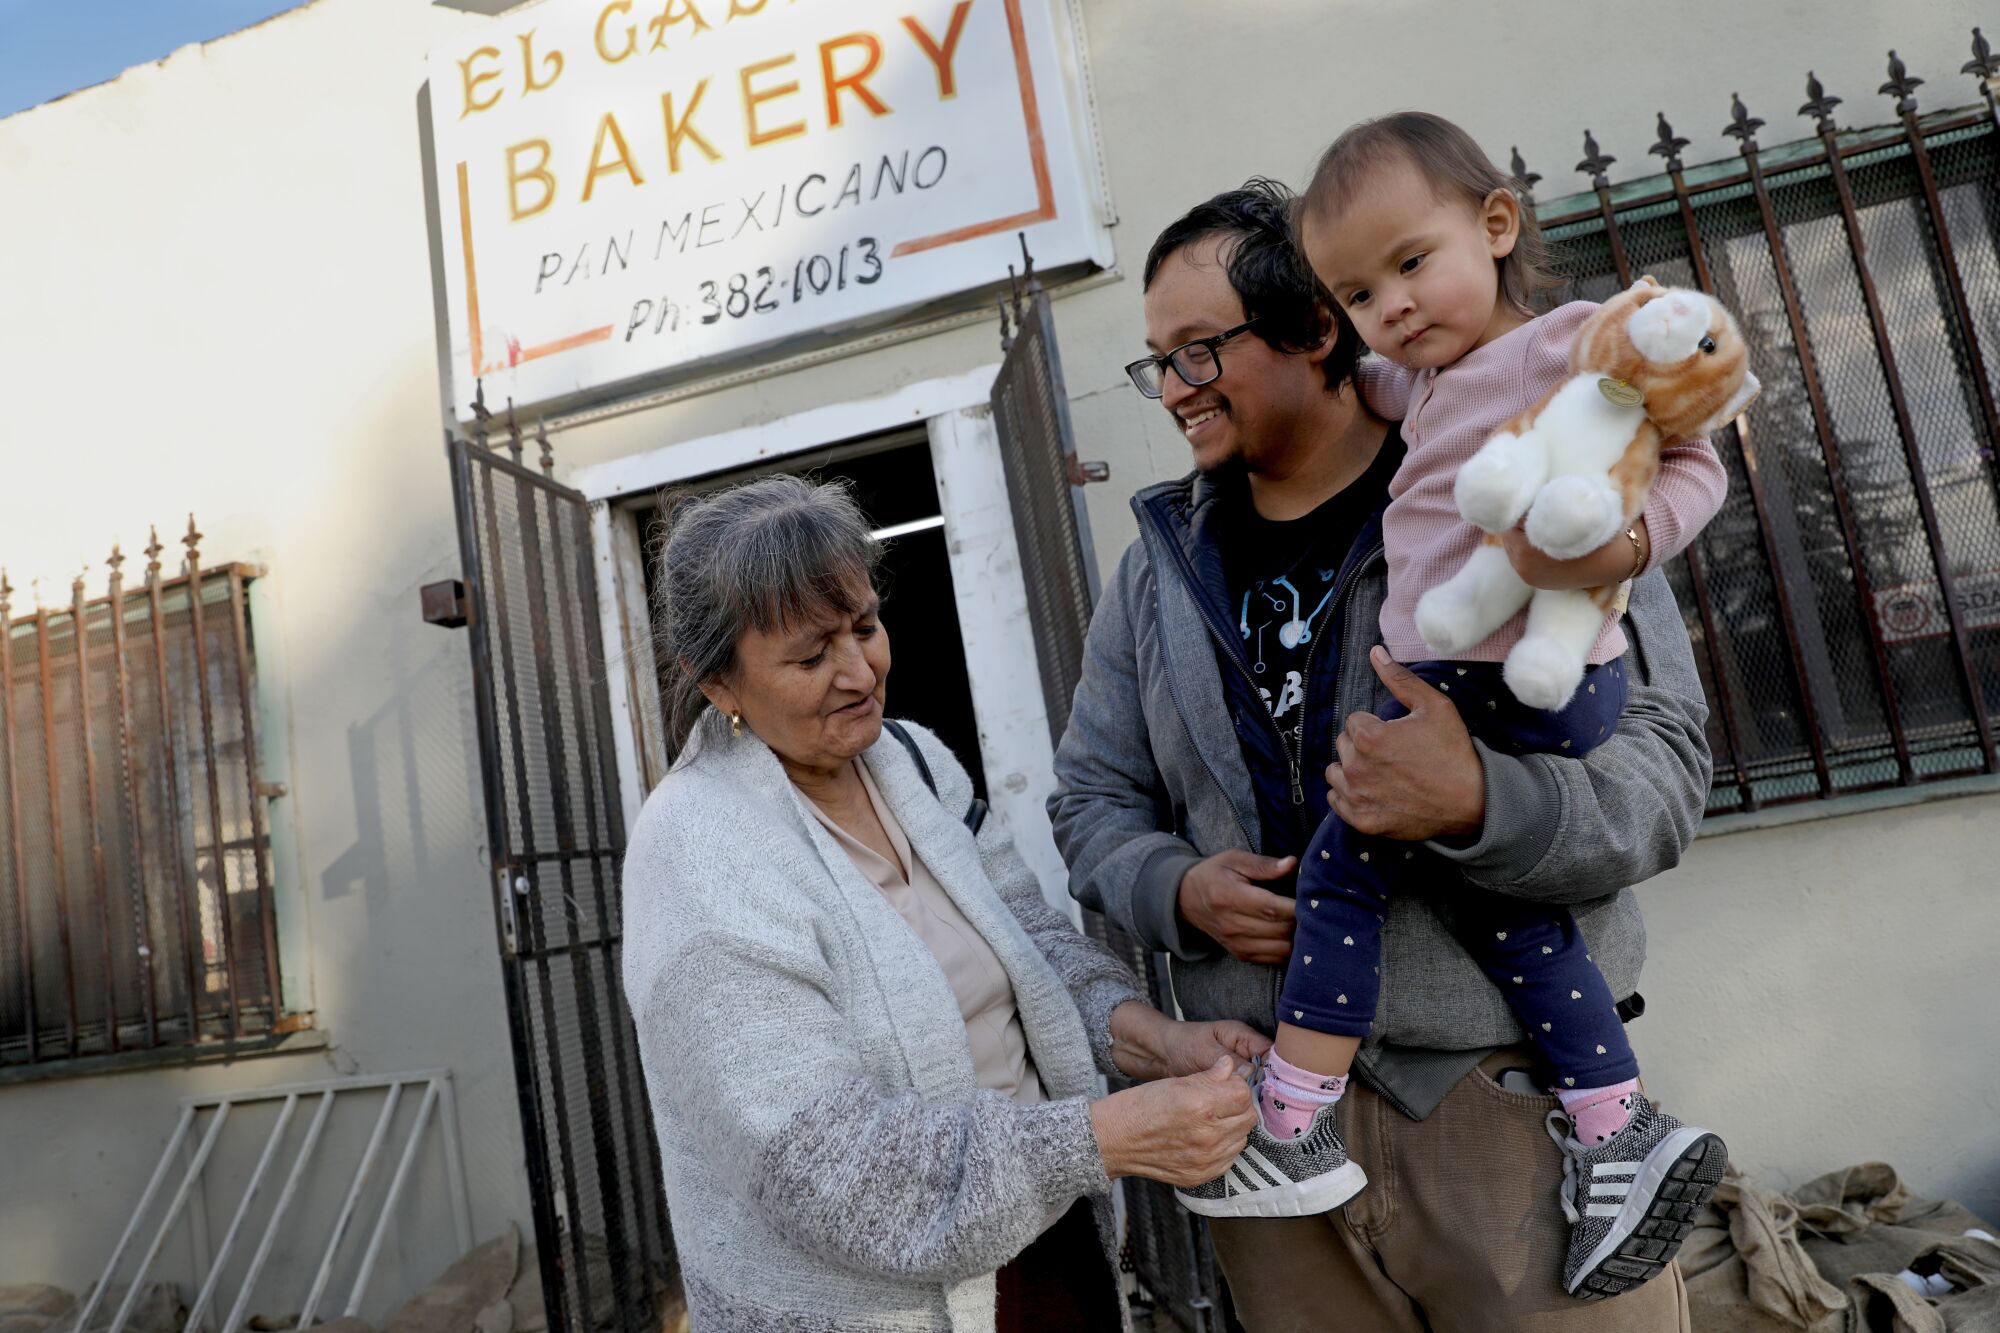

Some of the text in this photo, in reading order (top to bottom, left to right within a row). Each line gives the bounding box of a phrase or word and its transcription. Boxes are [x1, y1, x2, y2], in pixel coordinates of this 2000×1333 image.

[456, 27, 564, 121] EL
[504, 0, 976, 222] BAKERY
[534, 145, 948, 294] PAN MEXICANO
